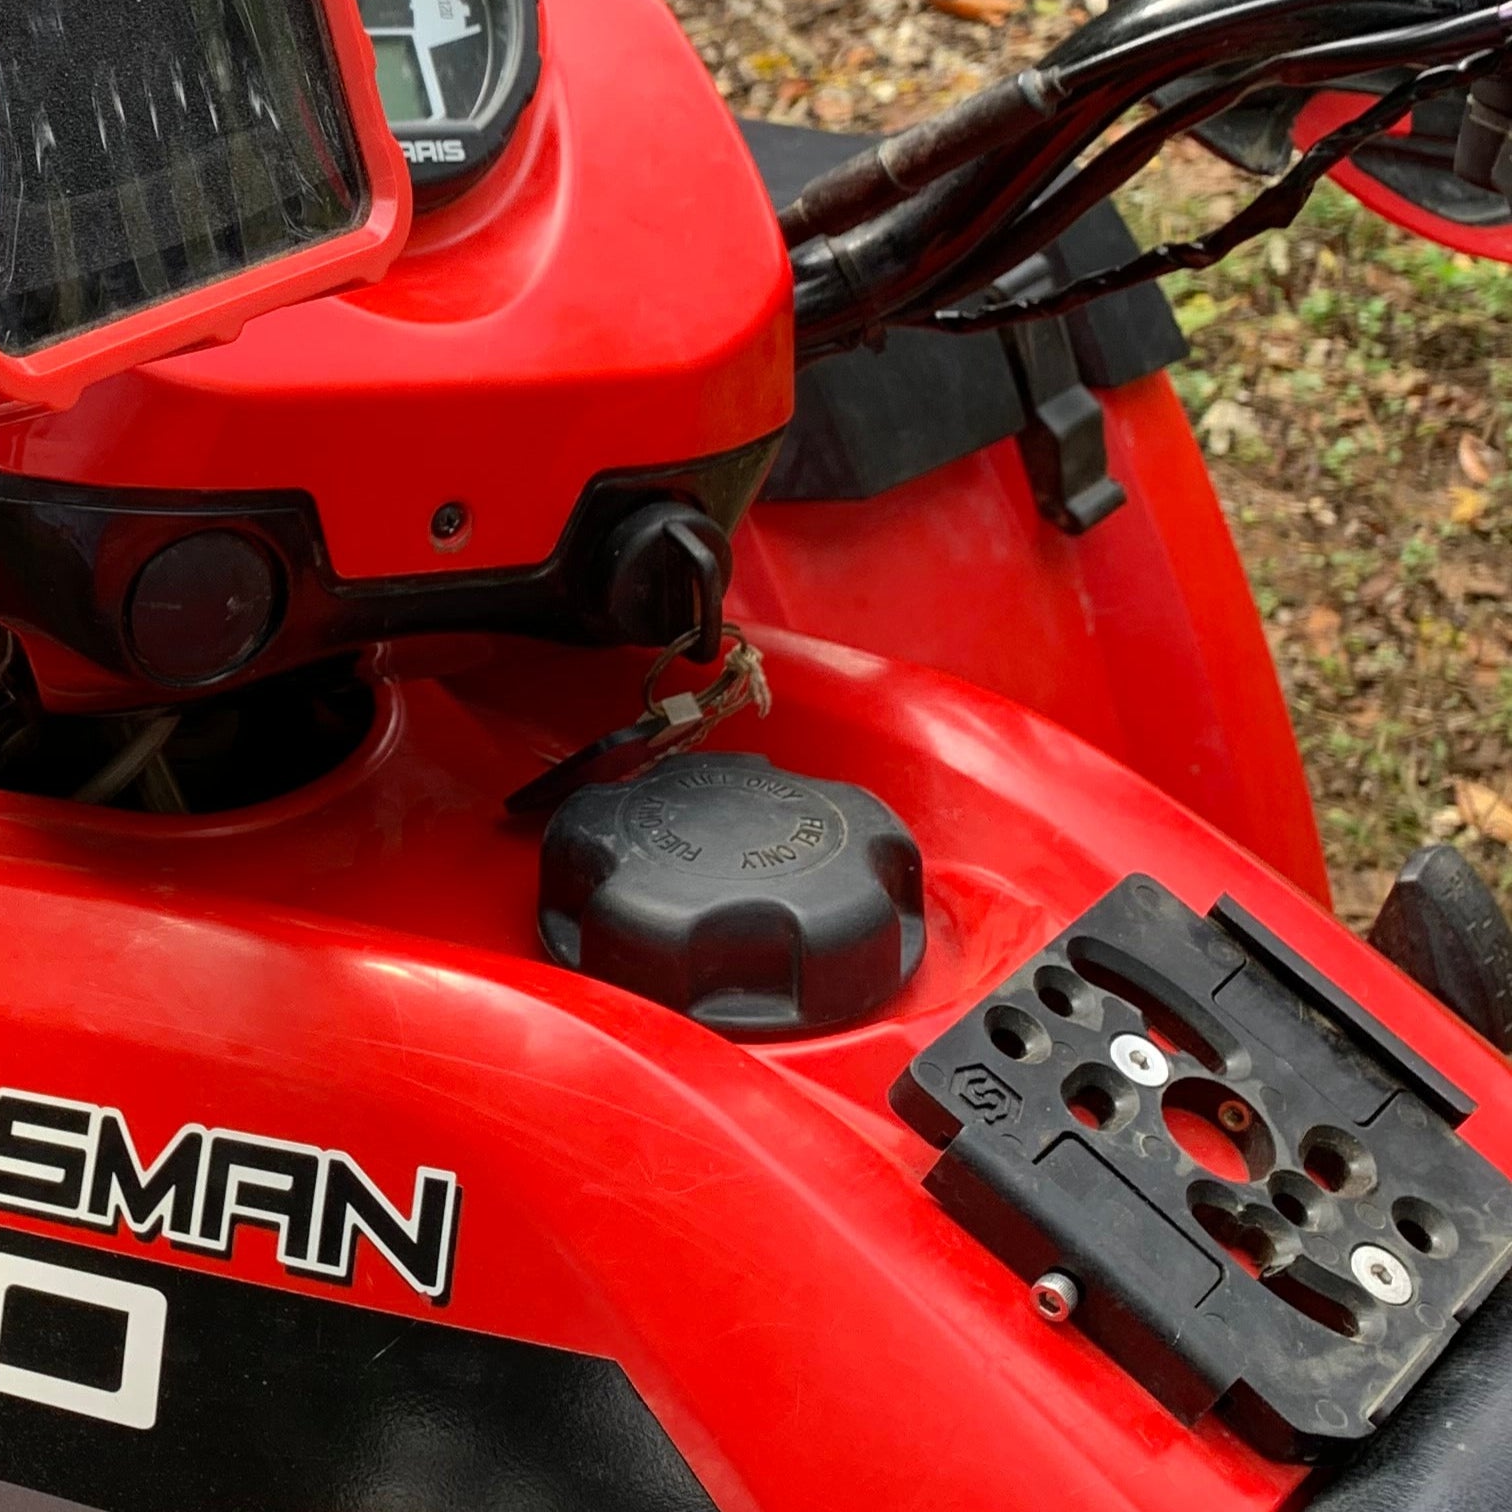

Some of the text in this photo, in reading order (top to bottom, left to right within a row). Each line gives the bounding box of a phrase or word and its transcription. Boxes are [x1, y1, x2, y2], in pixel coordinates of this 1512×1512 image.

[399, 140, 466, 163] ARIS
[746, 777, 804, 800] ONLY
[652, 829, 702, 862] FUEL
[741, 844, 797, 869] ONLY
